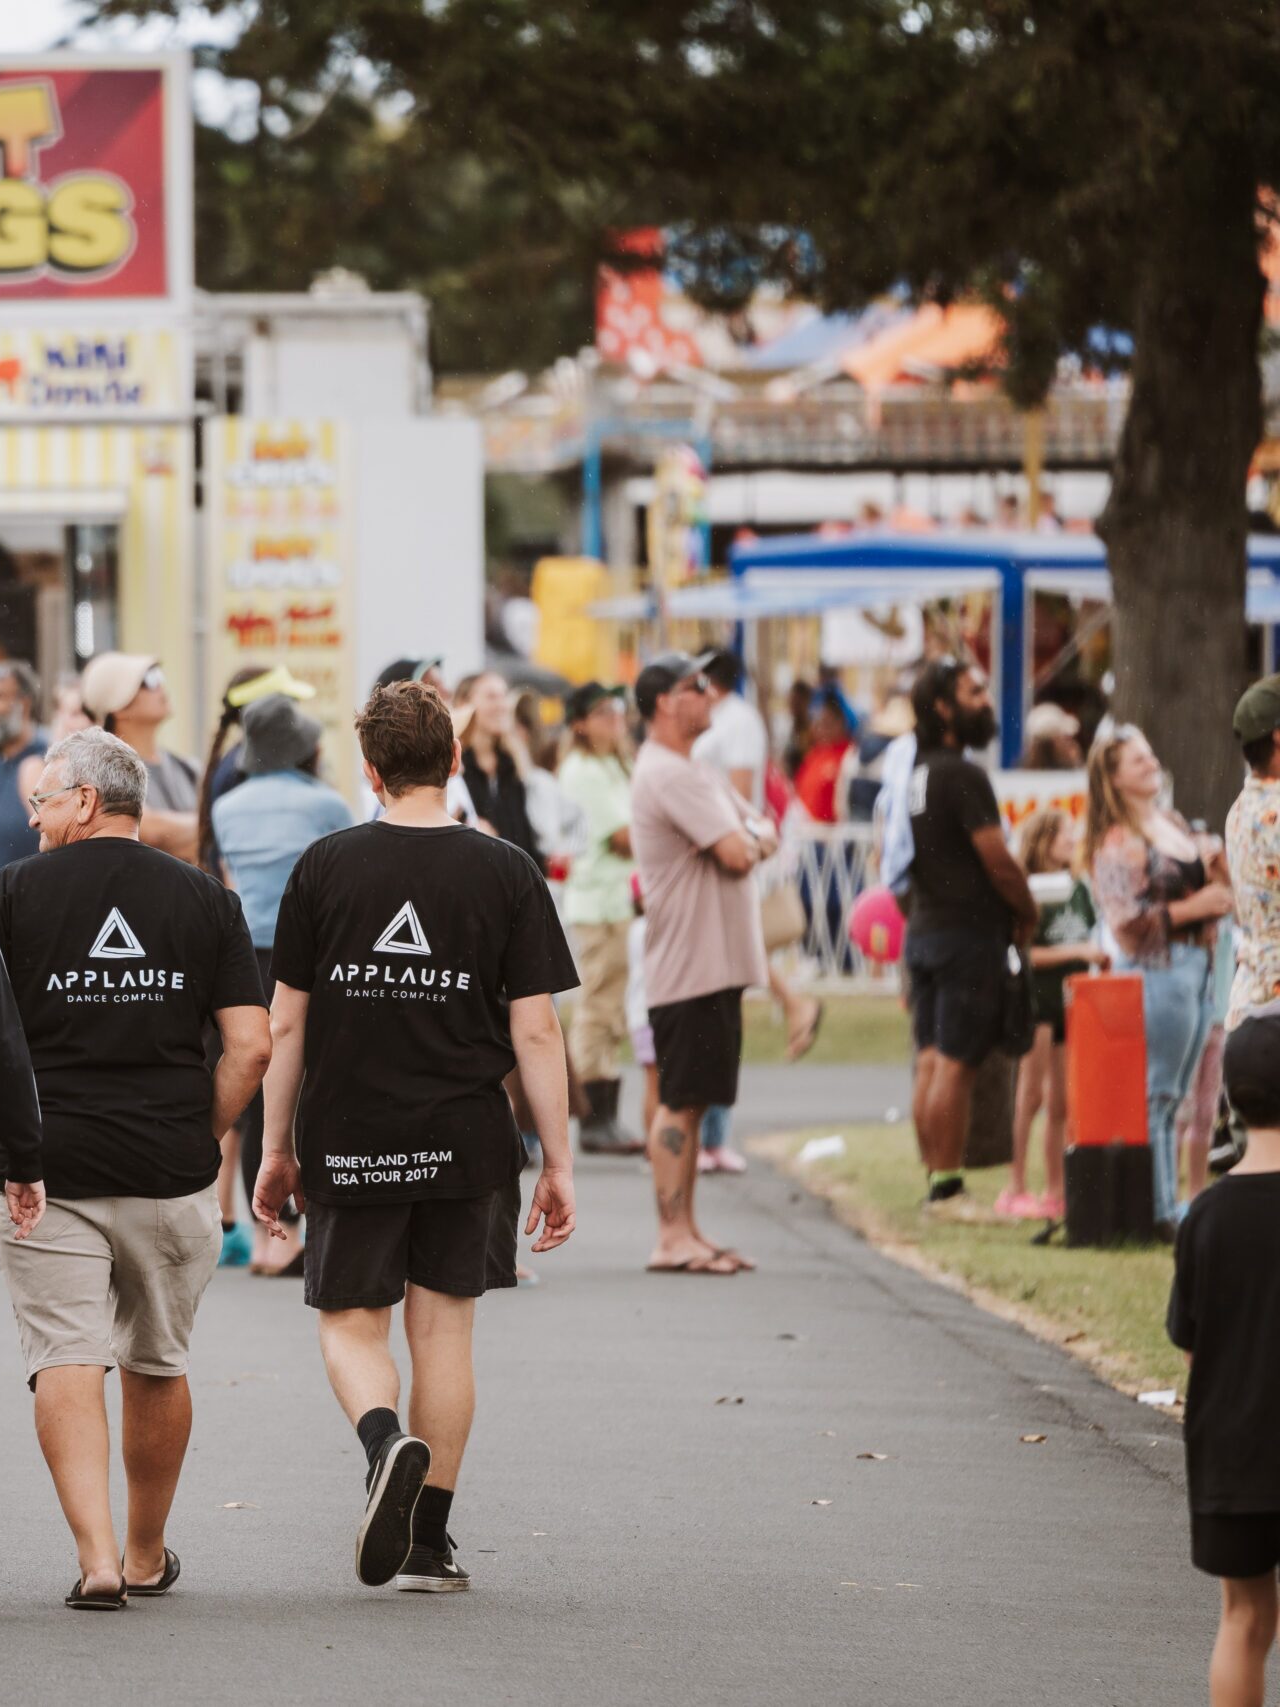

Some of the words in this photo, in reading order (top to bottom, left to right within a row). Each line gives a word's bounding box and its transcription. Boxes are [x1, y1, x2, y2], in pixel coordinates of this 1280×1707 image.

[46, 969, 184, 991] APPLAUSE
[330, 964, 471, 990] APPLAUSE
[67, 994, 107, 1003] DANCE
[113, 993, 164, 1003] COMPLEX
[346, 988, 385, 998] DANCE
[391, 990, 447, 1002] COMPLEX
[325, 1154, 408, 1168] DISNEYLAND
[412, 1150, 452, 1164] TEAM
[332, 1172, 359, 1185] USA
[362, 1171, 401, 1183] TOUR
[405, 1167, 438, 1181] 2017
